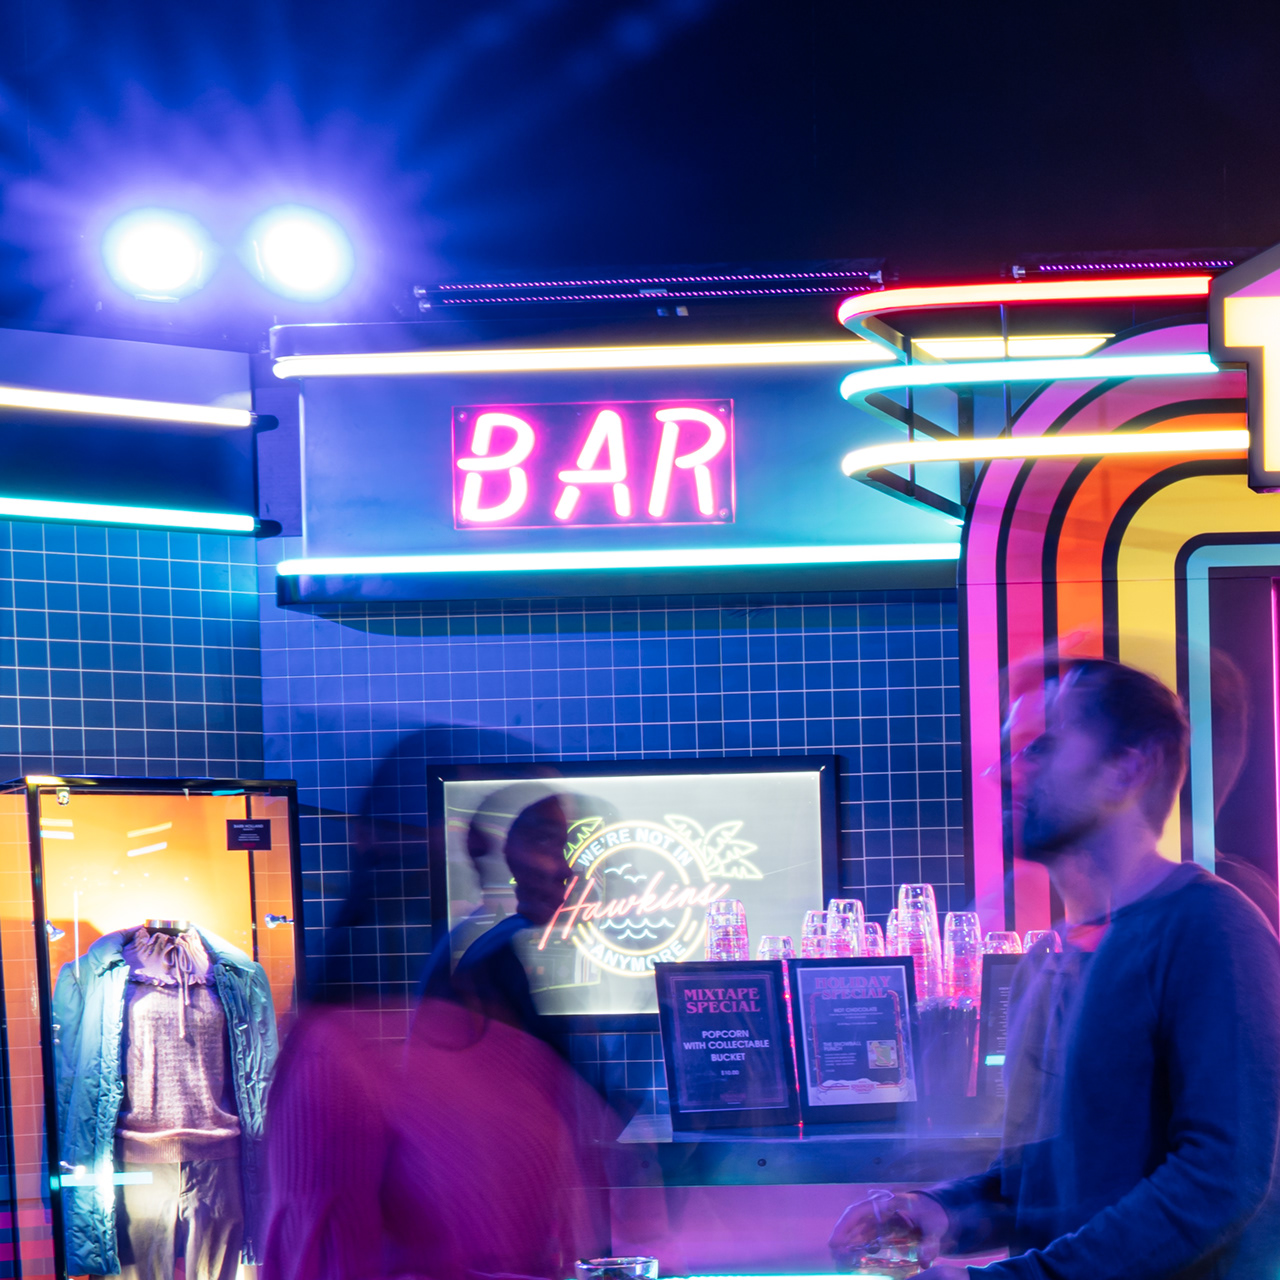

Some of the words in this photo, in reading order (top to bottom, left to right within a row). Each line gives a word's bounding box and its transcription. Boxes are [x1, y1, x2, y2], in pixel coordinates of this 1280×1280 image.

[455, 406, 727, 523] BAR
[577, 827, 631, 867] WE'RE
[635, 827, 675, 851] NOT
[672, 843, 694, 868] IN
[537, 870, 731, 951] Hawkins
[588, 939, 687, 972] ANYMORE
[814, 975, 891, 990] HOLIDAY
[684, 987, 760, 1001] MIXTAPE
[821, 988, 888, 1001] SPECIAL
[686, 1000, 761, 1014] SPECIAL
[701, 1029, 750, 1039] POPCORN
[683, 1041, 707, 1050] WITH
[708, 1039, 770, 1050] COLLECTABLE
[710, 1052, 746, 1062] BUCKET
